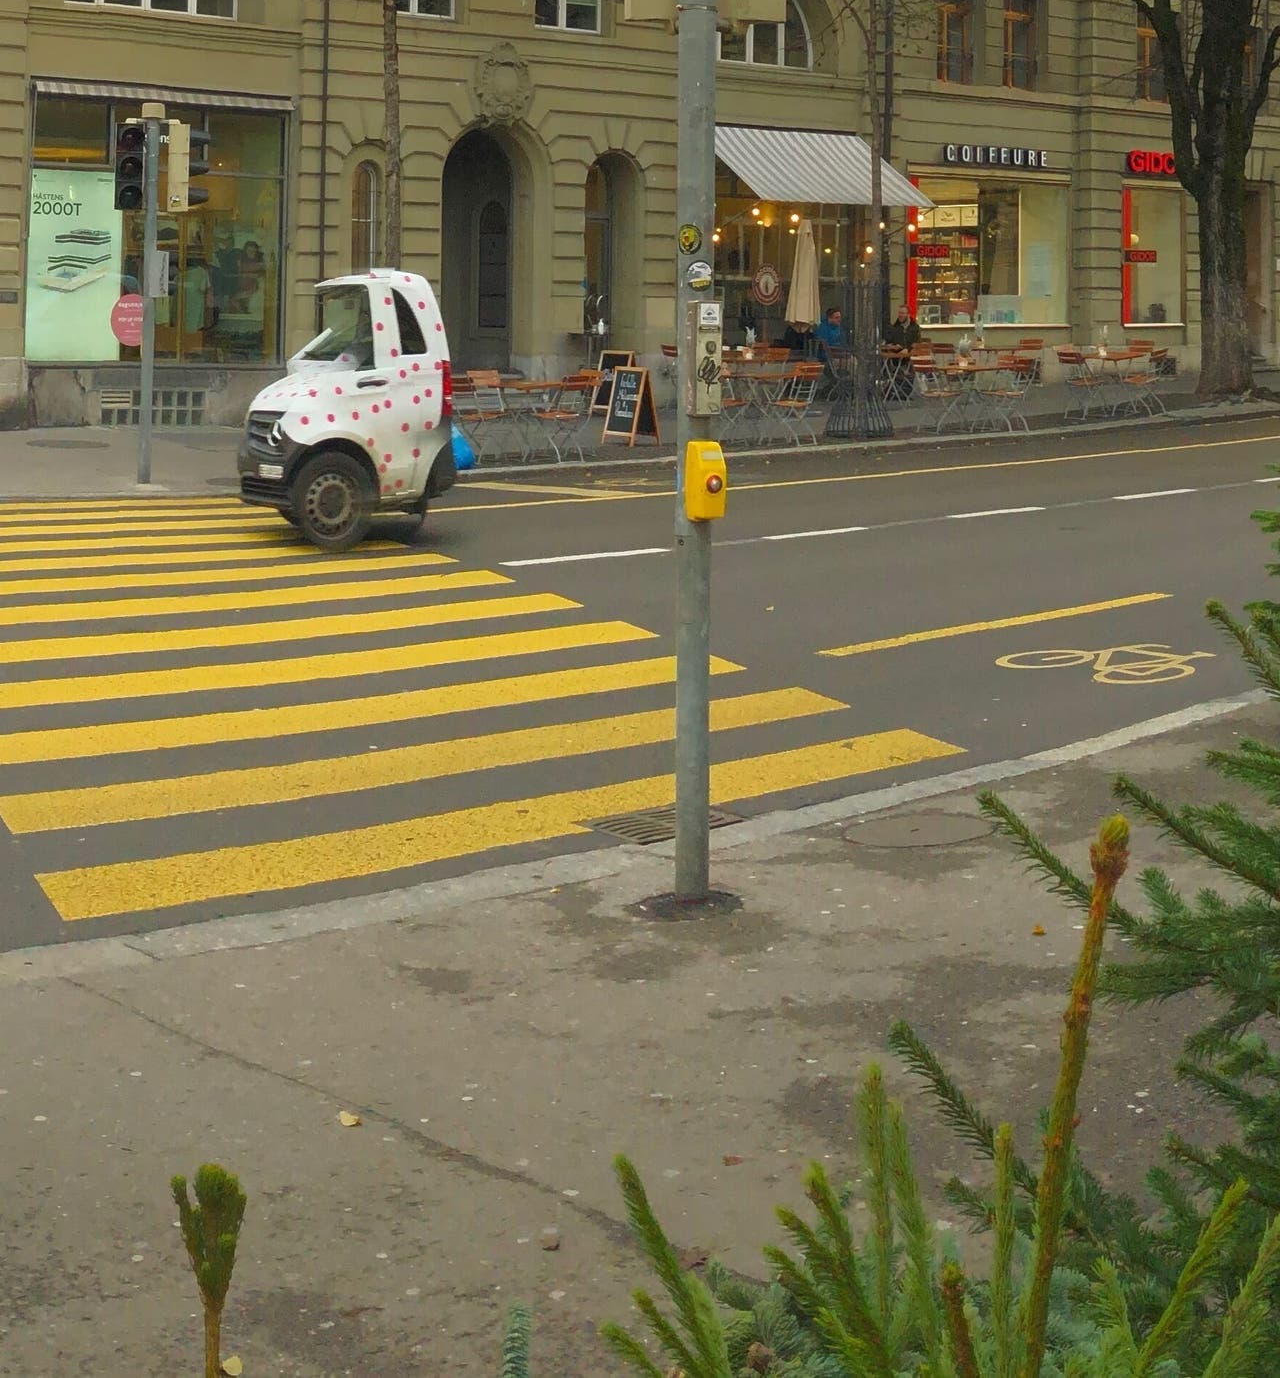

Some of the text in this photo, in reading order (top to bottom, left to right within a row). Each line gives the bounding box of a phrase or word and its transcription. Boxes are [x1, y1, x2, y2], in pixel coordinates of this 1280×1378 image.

[946, 144, 1048, 167] COIFFURE
[1128, 150, 1176, 174] GIDO
[32, 201, 83, 217] 2000T
[916, 245, 950, 257] GIDOR
